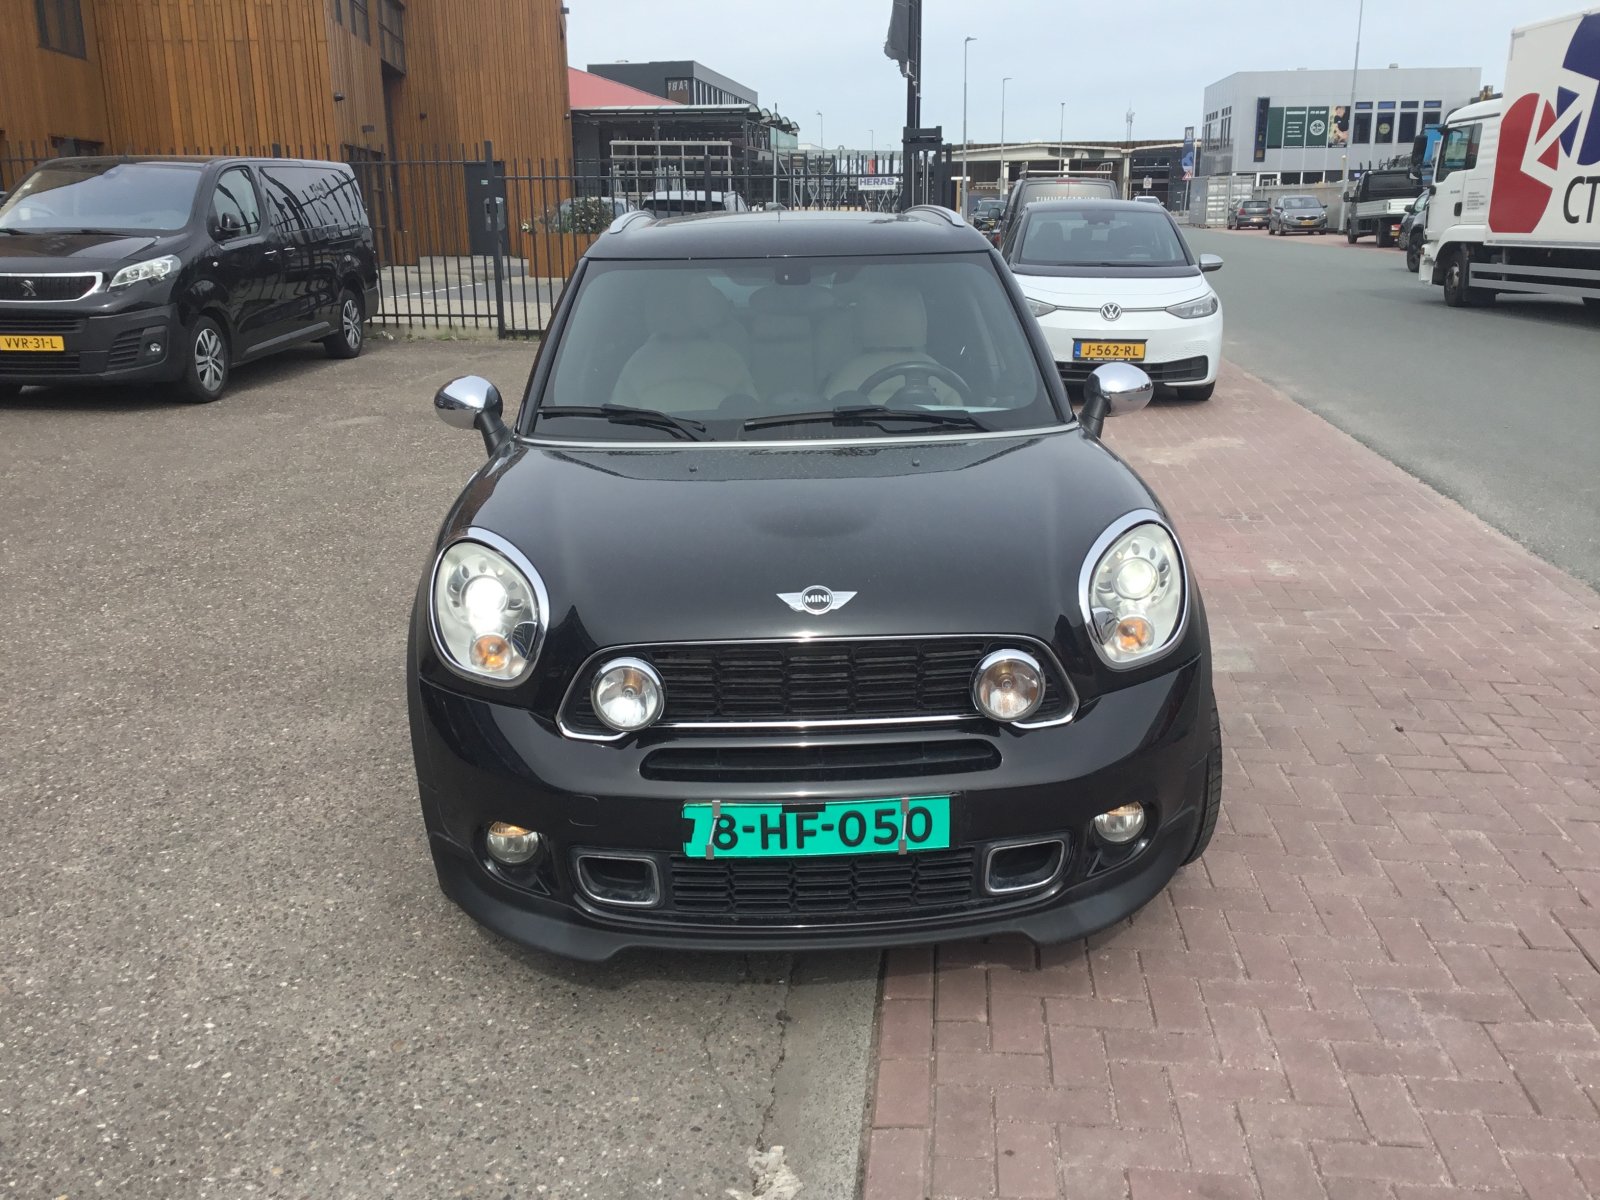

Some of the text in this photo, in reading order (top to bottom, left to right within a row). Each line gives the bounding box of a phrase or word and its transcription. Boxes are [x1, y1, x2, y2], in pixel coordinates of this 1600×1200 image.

[860, 177, 895, 186] HERAS
[1563, 175, 1600, 224] CT
[5, 337, 58, 349] VVR-31-L
[1085, 345, 1139, 356] J-562-RL
[805, 594, 830, 603] MINI
[712, 806, 933, 851] 8-HF-050
